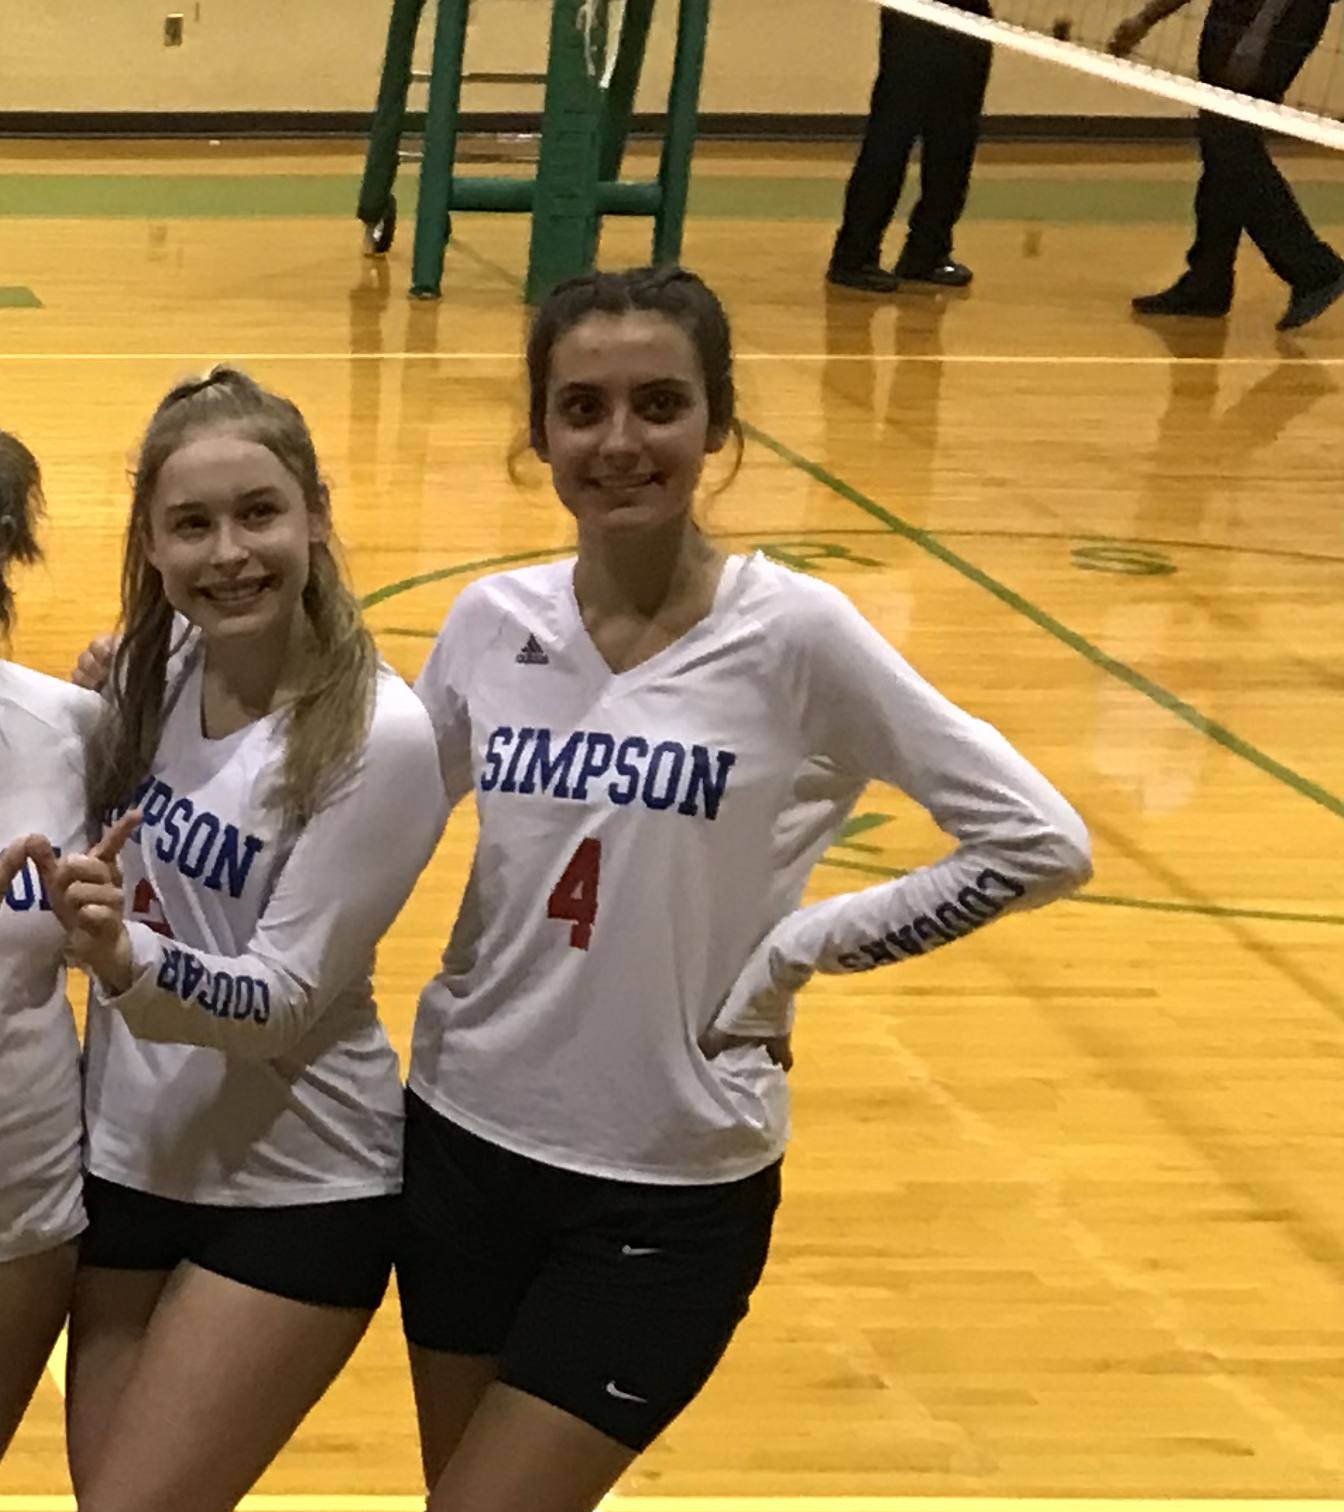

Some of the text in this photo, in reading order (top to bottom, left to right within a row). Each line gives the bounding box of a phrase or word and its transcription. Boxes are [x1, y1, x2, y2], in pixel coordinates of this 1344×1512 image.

[480, 726, 736, 821] SIMPSON
[547, 837, 602, 951] 4
[837, 868, 1024, 974] COUGARS
